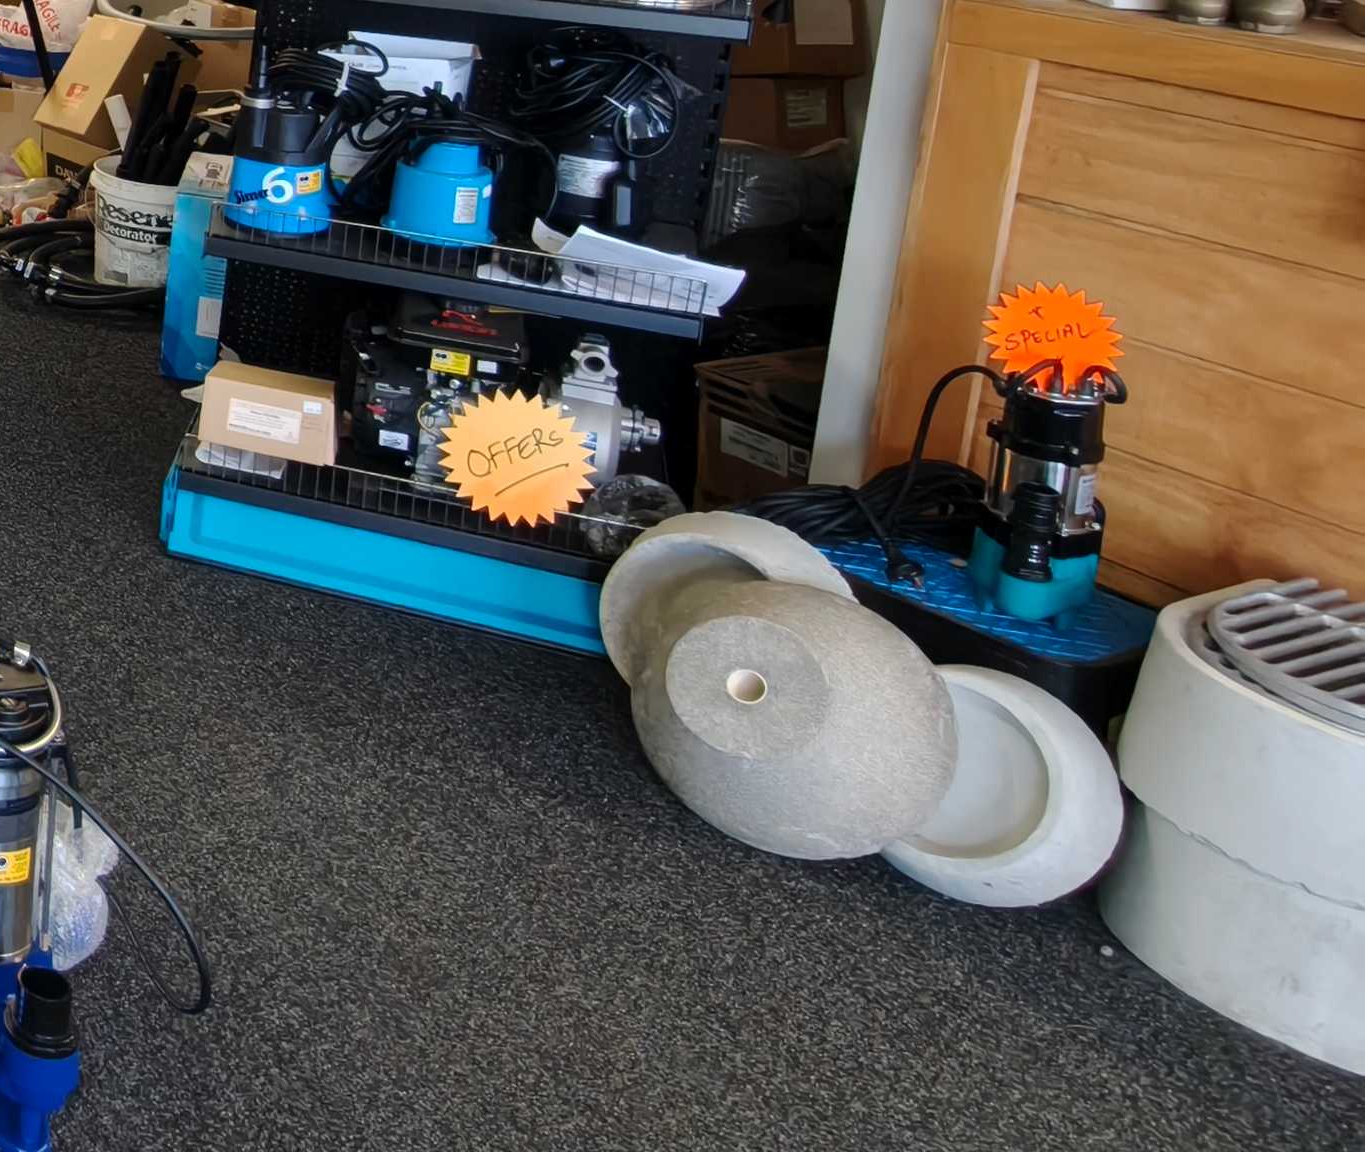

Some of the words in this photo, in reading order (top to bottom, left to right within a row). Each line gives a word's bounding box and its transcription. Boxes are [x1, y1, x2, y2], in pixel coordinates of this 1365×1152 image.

[262, 167, 293, 203] 6
[102, 222, 159, 244] Decorator
[1004, 322, 1090, 351] SPECIAL
[466, 429, 564, 479] OFFERS
